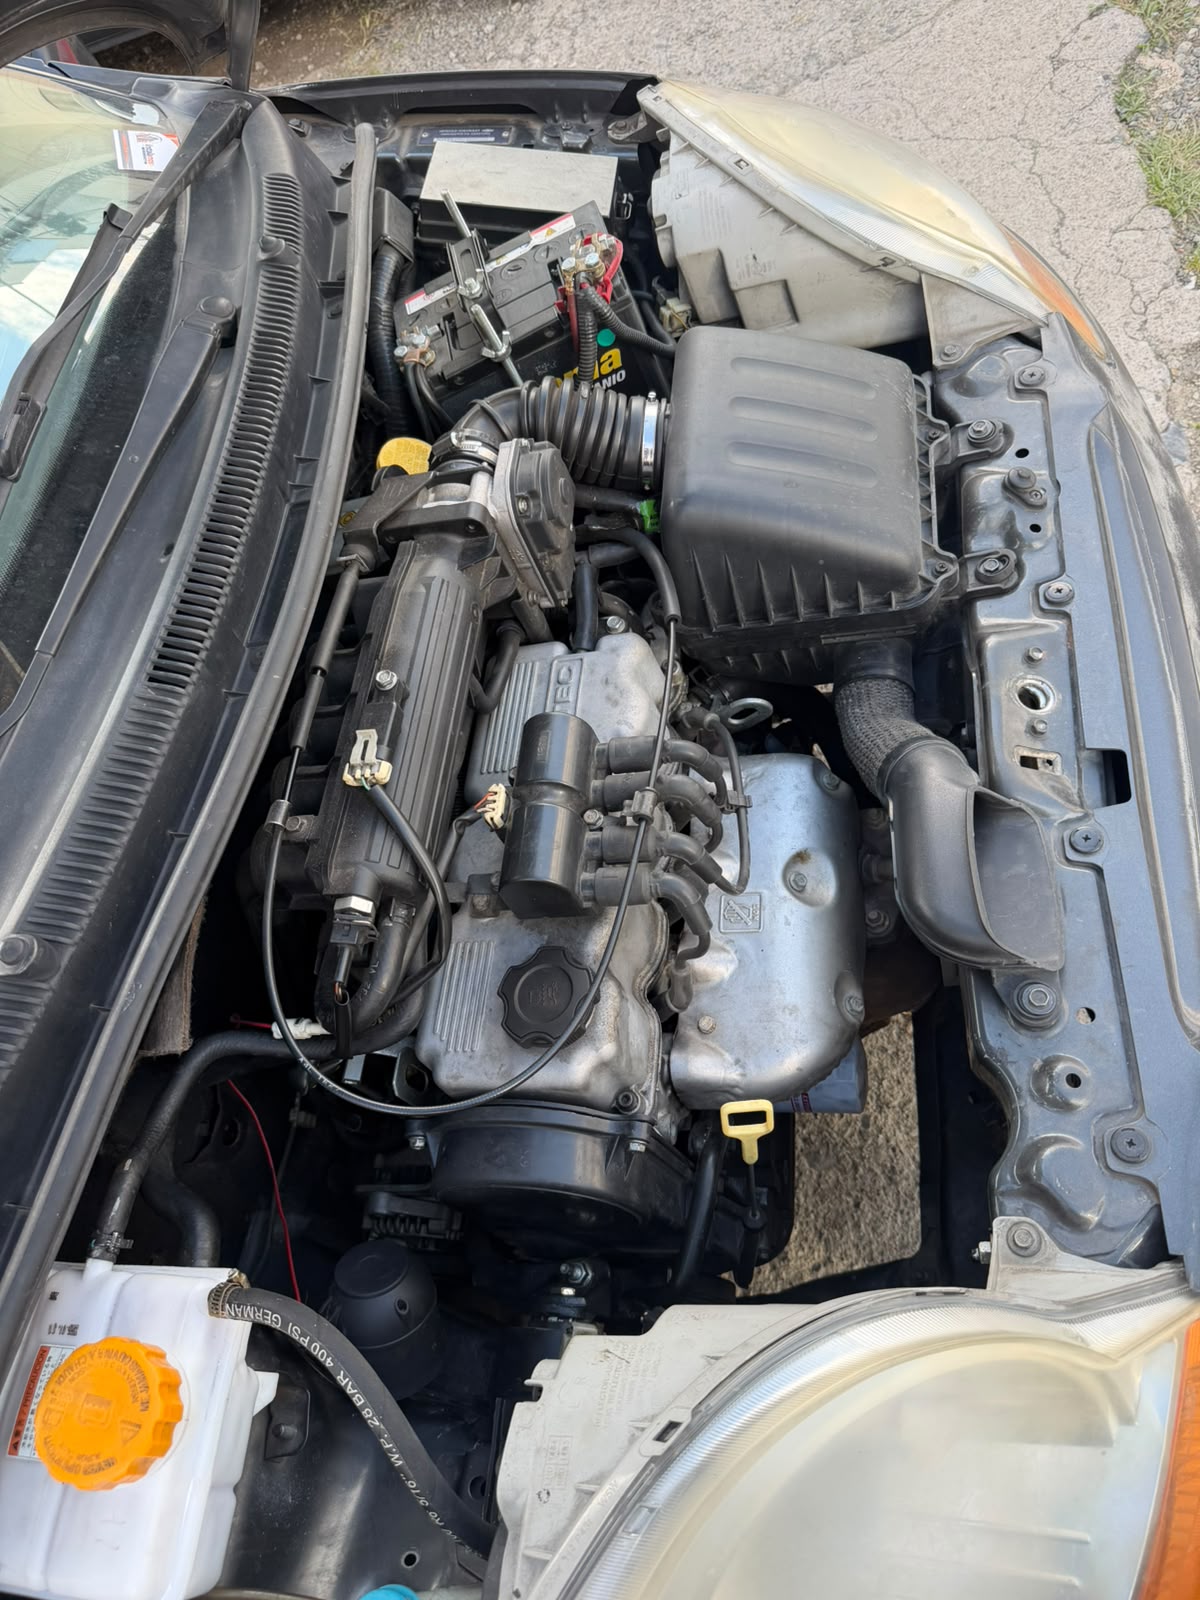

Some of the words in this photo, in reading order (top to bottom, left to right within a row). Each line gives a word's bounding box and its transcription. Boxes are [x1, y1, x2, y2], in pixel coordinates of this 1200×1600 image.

[225, 1303, 282, 1328] GERMAN
[287, 1322, 310, 1347] PSI
[310, 1342, 334, 1367] 400
[335, 1370, 366, 1407] BAR
[360, 1407, 381, 1429] 28
[378, 1432, 404, 1467] W.P.
